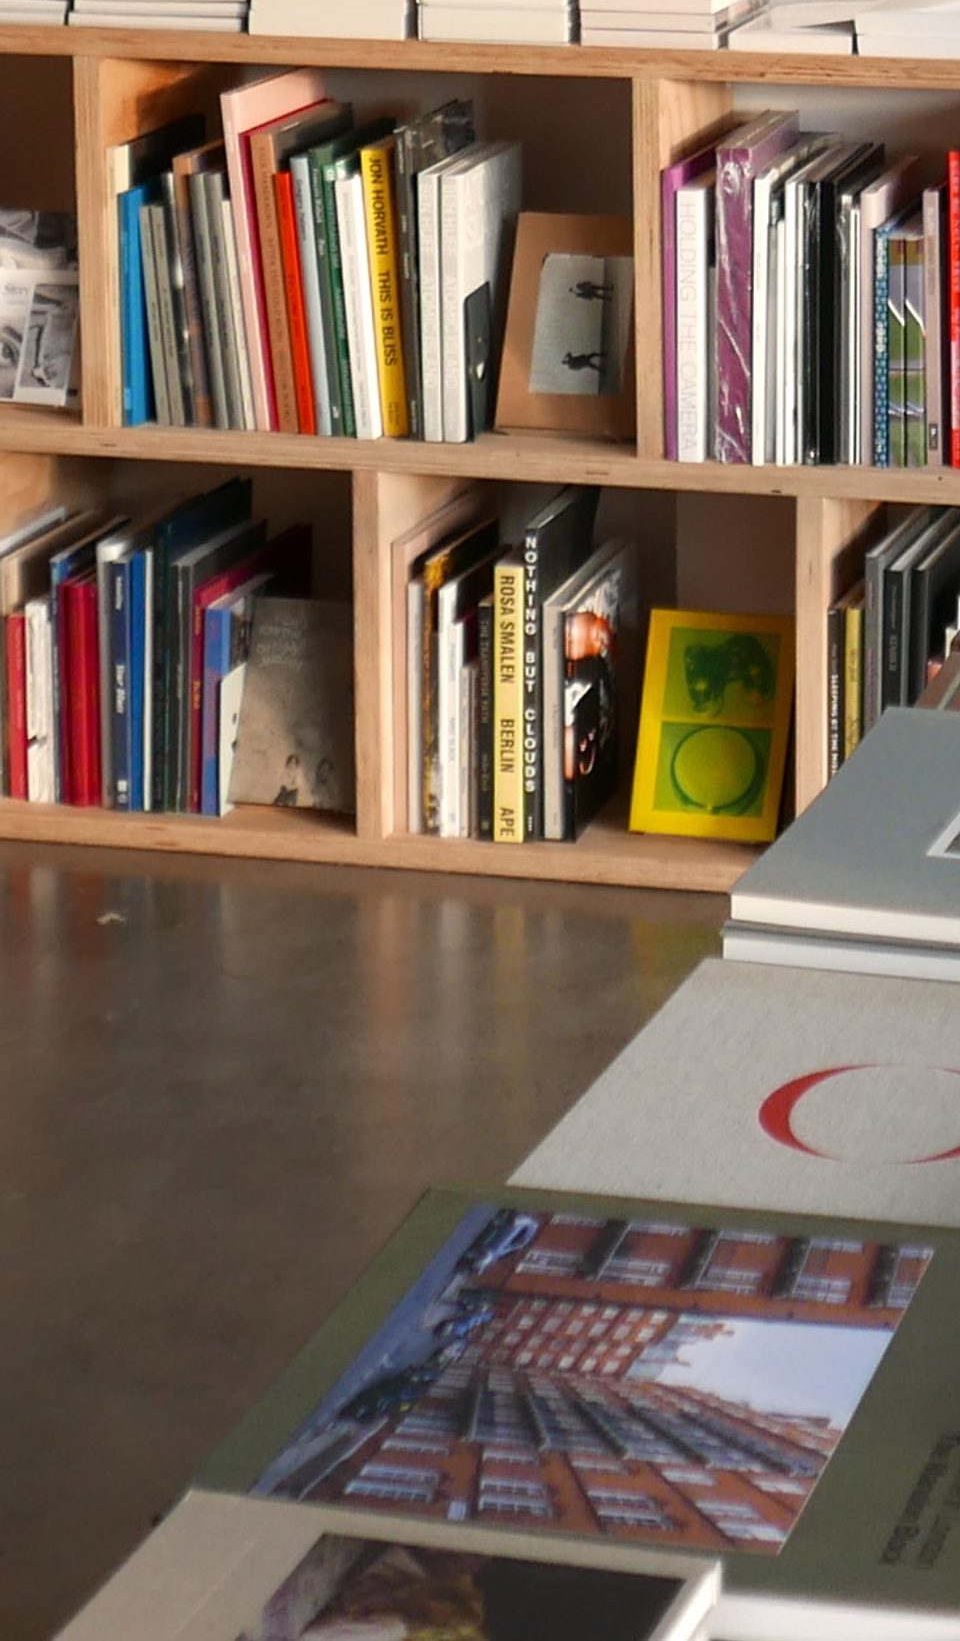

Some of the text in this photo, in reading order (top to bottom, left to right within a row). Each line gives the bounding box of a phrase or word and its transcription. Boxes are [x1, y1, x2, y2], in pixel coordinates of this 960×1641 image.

[368, 157, 397, 368] JON HORVATH THIS IS BLISS
[679, 203, 699, 451] HOLDING THE CAMERA
[499, 575, 515, 836] ROSA SMALEN BERLIN APE
[525, 536, 538, 794] NOTHING BUT CLOUDS
